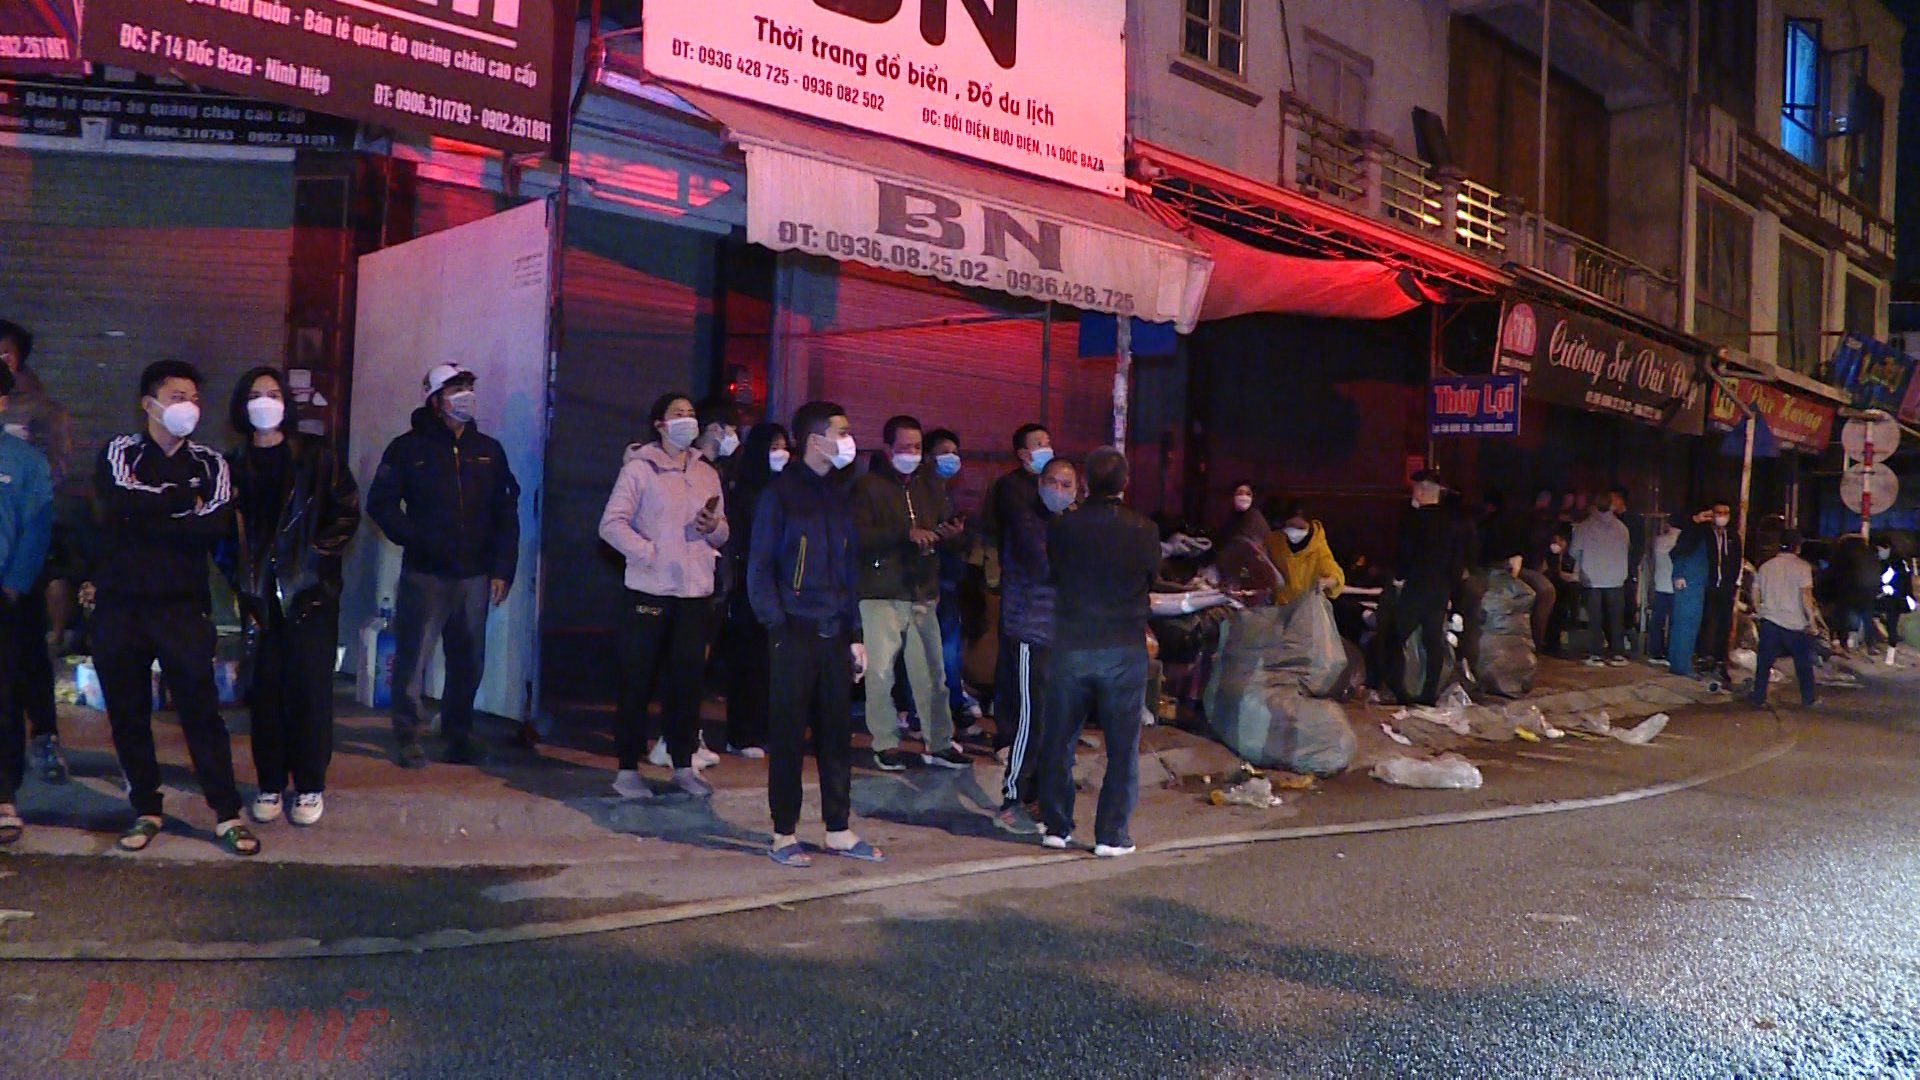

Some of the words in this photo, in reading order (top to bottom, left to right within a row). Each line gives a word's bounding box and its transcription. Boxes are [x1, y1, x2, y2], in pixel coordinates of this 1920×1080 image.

[151, 30, 161, 54] F
[164, 35, 184, 60] 14
[186, 39, 215, 66] Dốc
[217, 46, 253, 75] Baza
[265, 57, 298, 86] Ninh
[300, 64, 330, 96] Hiệp
[303, 8, 332, 36] Bán
[336, 15, 350, 40] lẻ
[353, 23, 388, 50] quần
[390, 31, 408, 54] áo
[454, 50, 485, 74] châu
[488, 59, 511, 81] cao
[514, 62, 537, 88] cấp
[698, 45, 732, 70] 0936
[736, 56, 762, 78] 428
[765, 63, 790, 86] 725
[802, 74, 833, 98] 0936
[837, 84, 859, 105] 082
[862, 90, 885, 112] 502
[754, 15, 803, 52] Thời
[811, 35, 868, 76] trang
[908, 61, 948, 95] biển
[999, 91, 1020, 116] du
[1026, 98, 1054, 128] lịch
[965, 119, 990, 141] DIỆN
[1046, 143, 1057, 158] 14
[1080, 152, 1105, 172] BAZA
[874, 179, 1063, 273] BN
[778, 220, 818, 249] ĐT:
[826, 230, 989, 283] 0936.08.25.02
[1006, 269, 1135, 313] 0936.428.725
